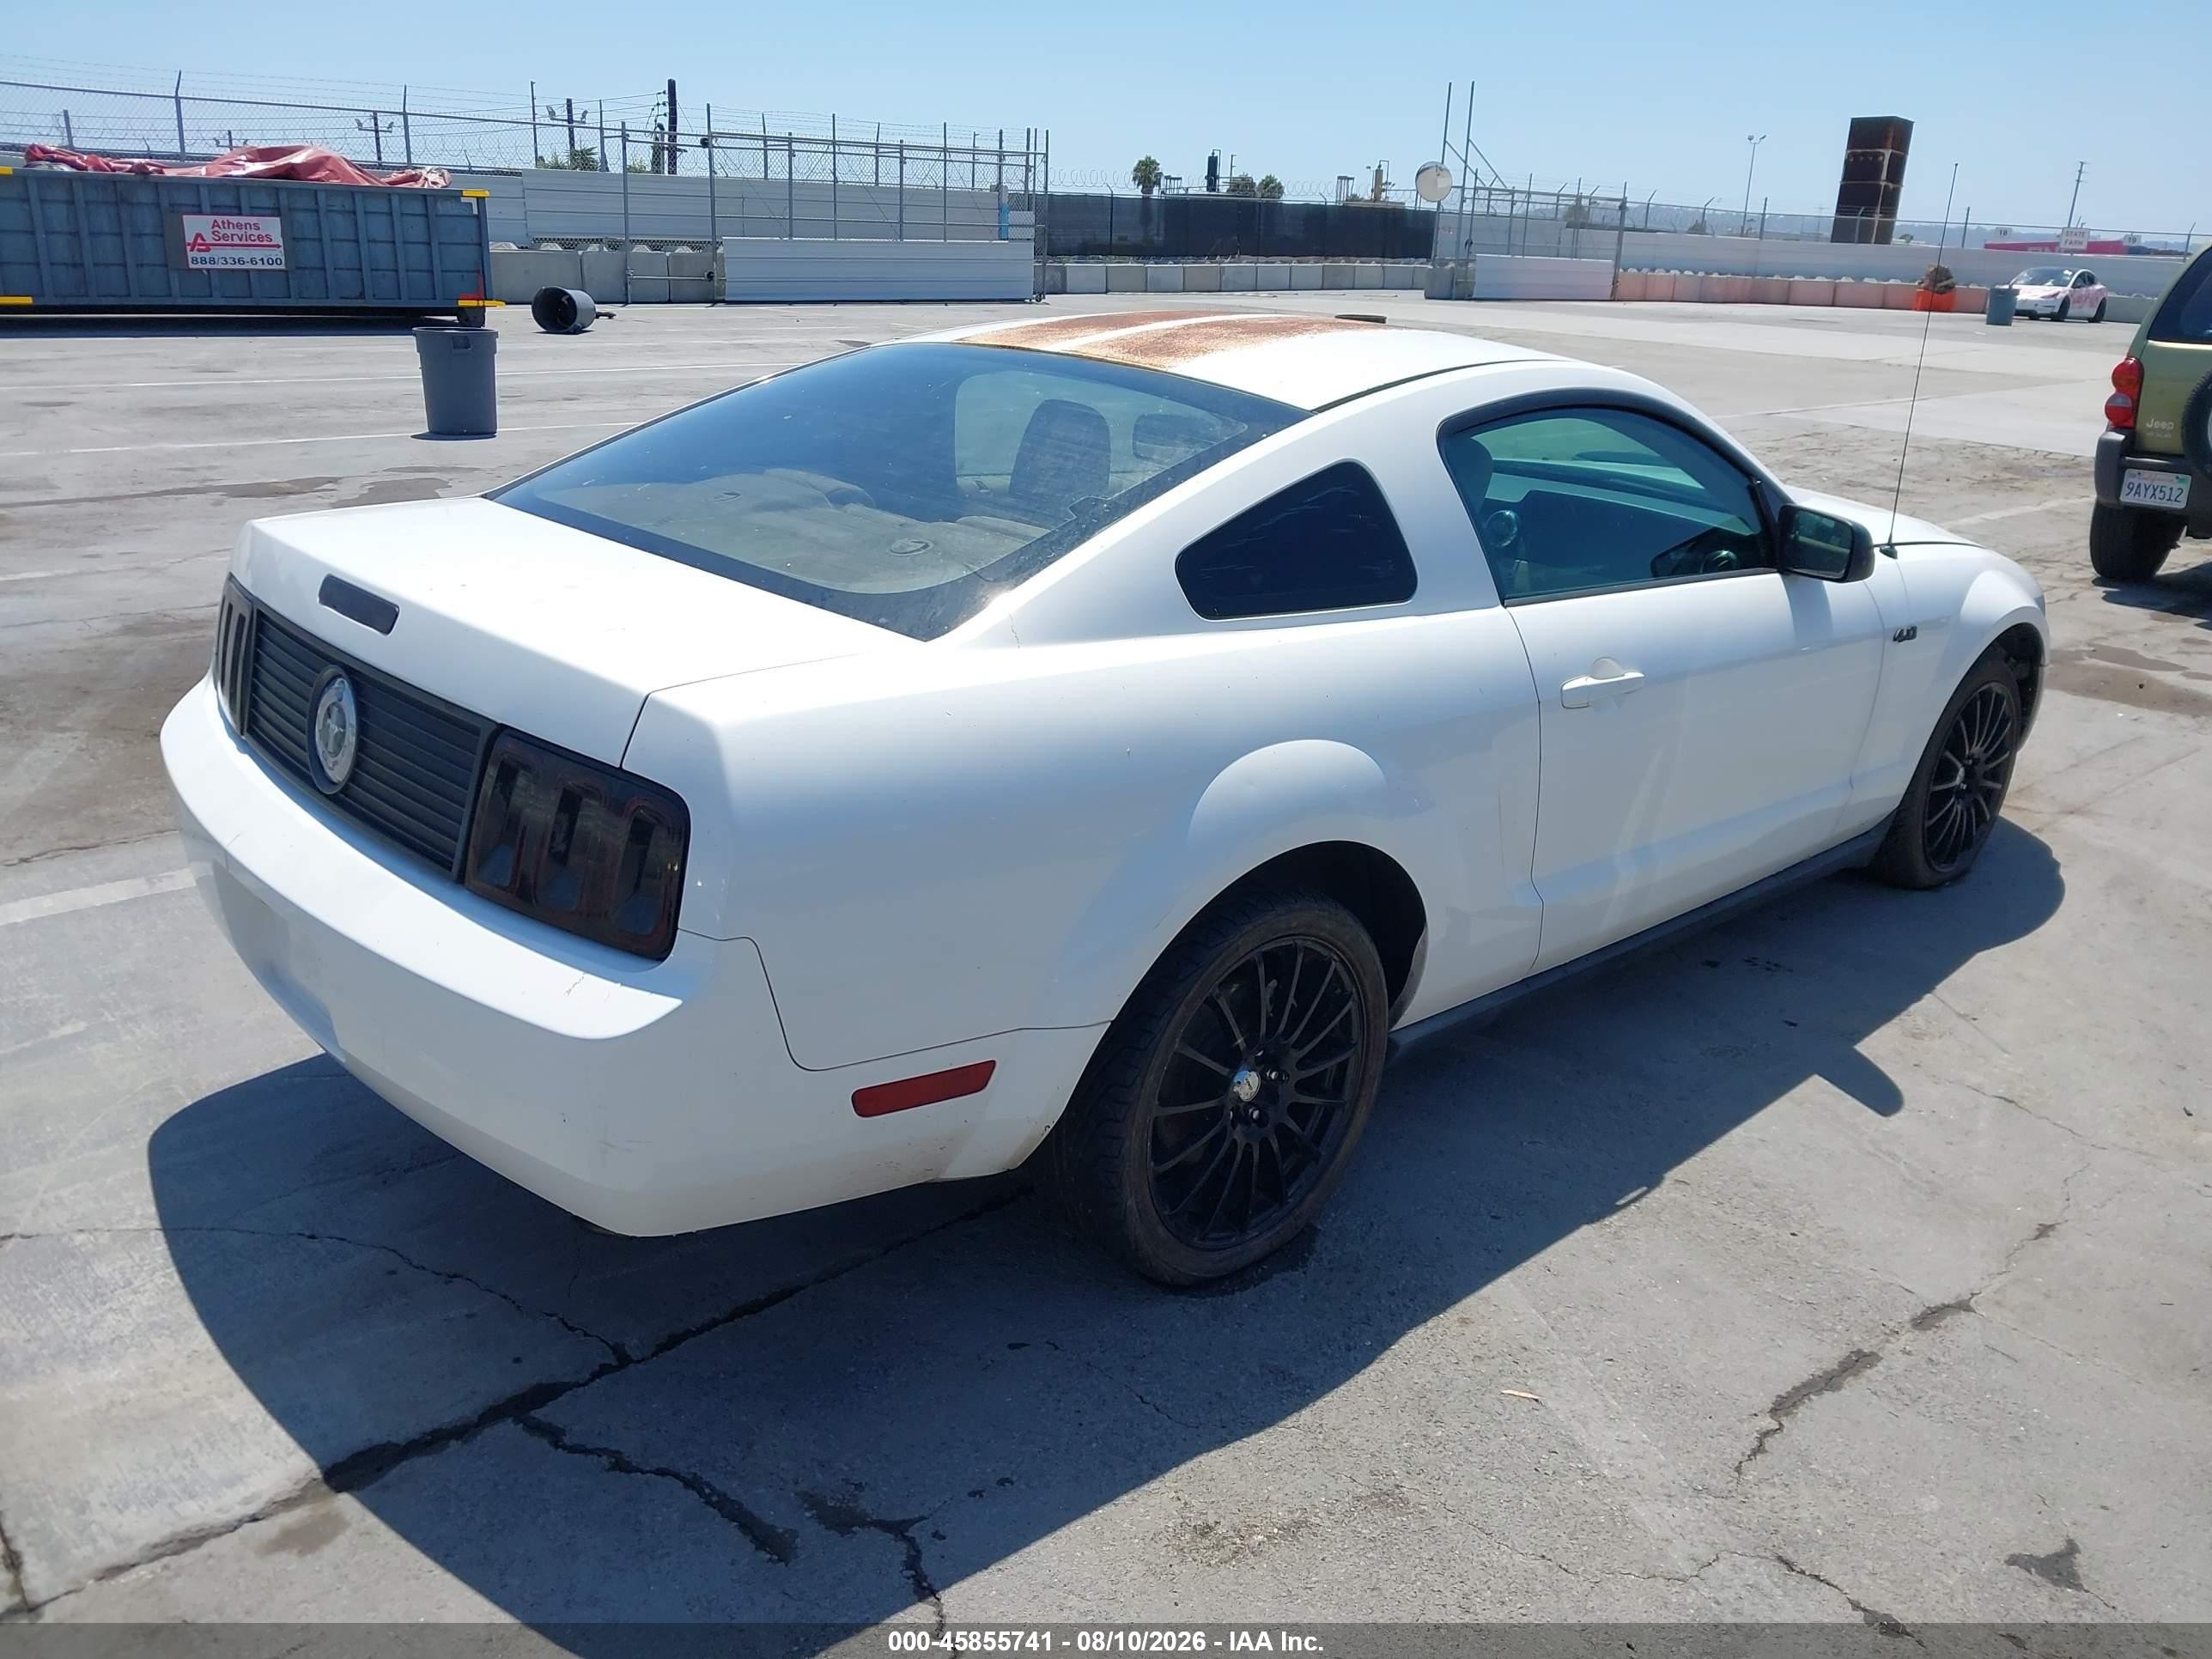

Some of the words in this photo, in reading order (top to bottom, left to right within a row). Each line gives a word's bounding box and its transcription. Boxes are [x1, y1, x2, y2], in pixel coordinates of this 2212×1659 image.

[211, 219, 261, 230] Athens
[212, 230, 273, 242] Services
[191, 256, 283, 266] 888/336-6100
[2146, 419, 2174, 431] Jeep
[2125, 482, 2184, 503] 9AYX512
